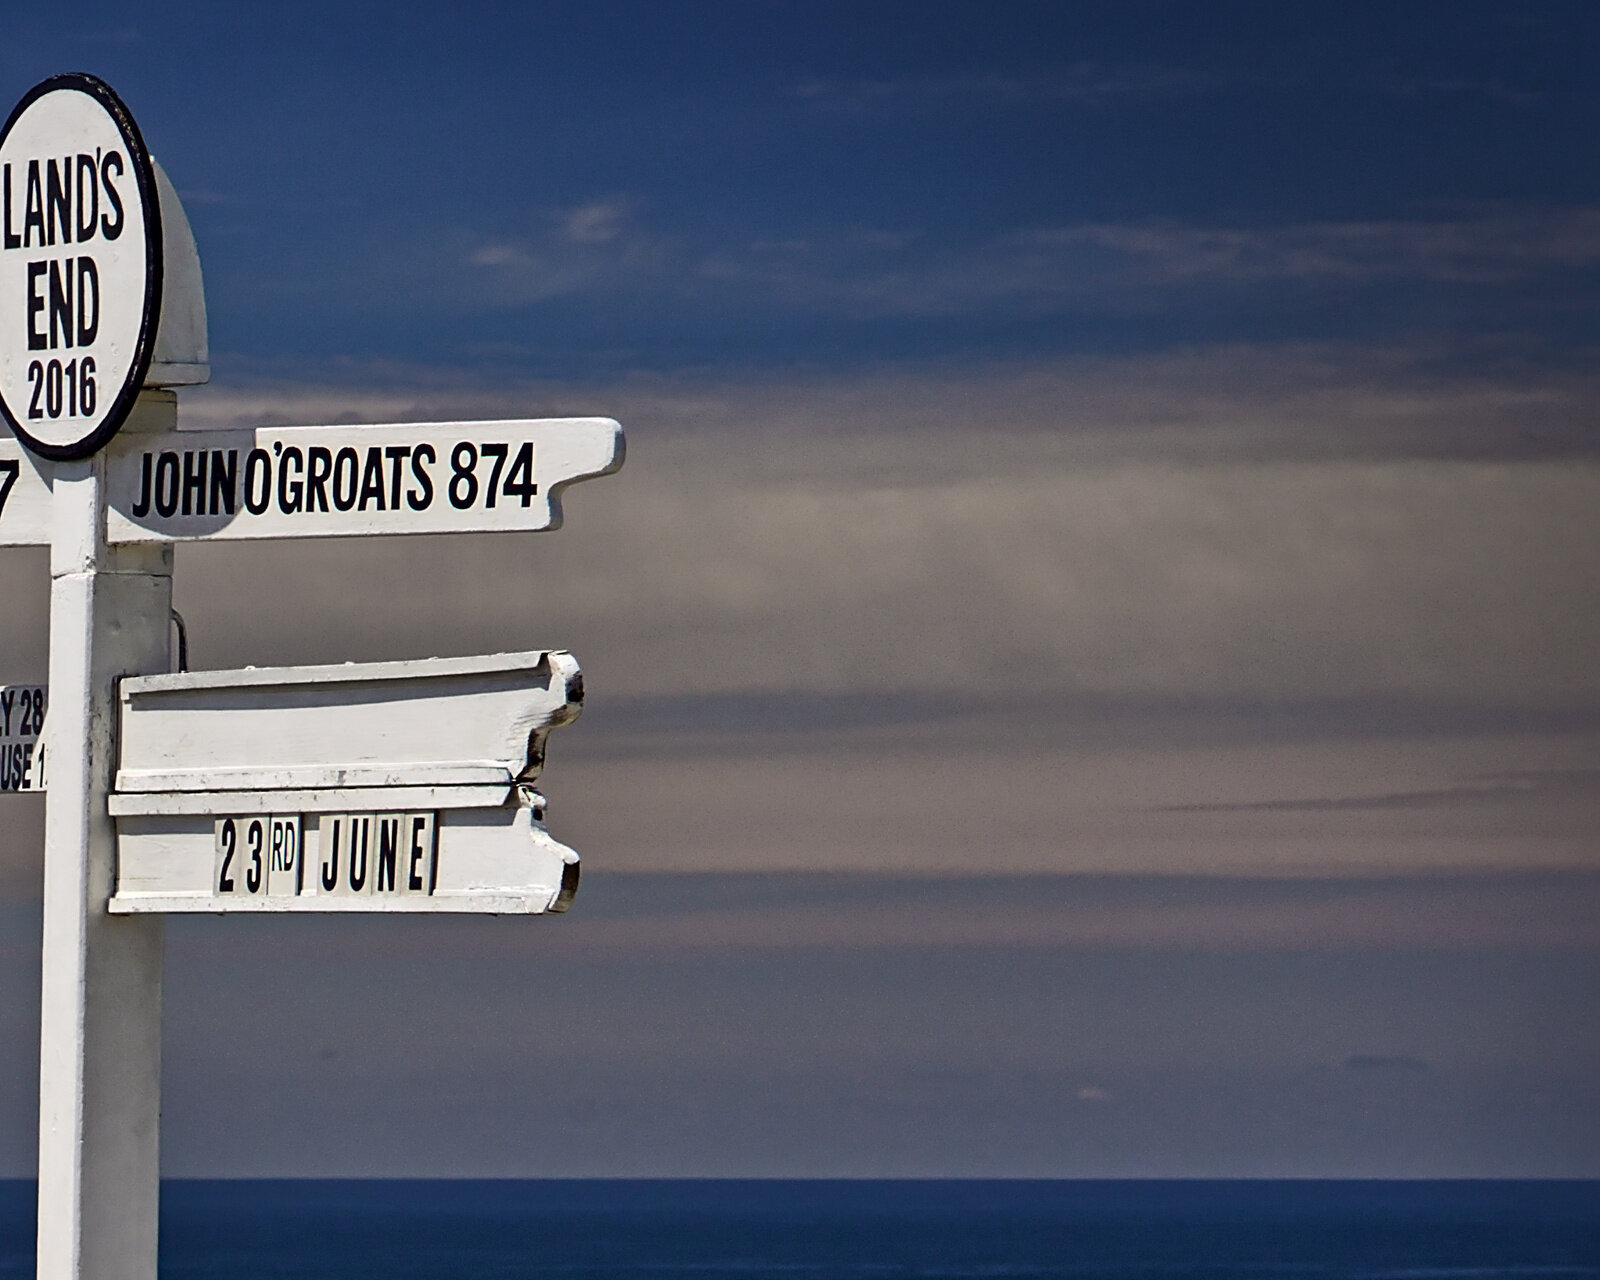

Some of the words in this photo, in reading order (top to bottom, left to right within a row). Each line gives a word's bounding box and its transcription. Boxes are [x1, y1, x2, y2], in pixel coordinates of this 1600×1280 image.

[3, 147, 124, 250] LAND'S
[27, 256, 99, 351] END
[28, 356, 97, 420] 2016
[132, 448, 239, 518] JOHN
[244, 441, 436, 516] O'GROATS
[448, 441, 538, 510] 874
[20, 689, 43, 736] 28
[322, 817, 425, 892] JUNE
